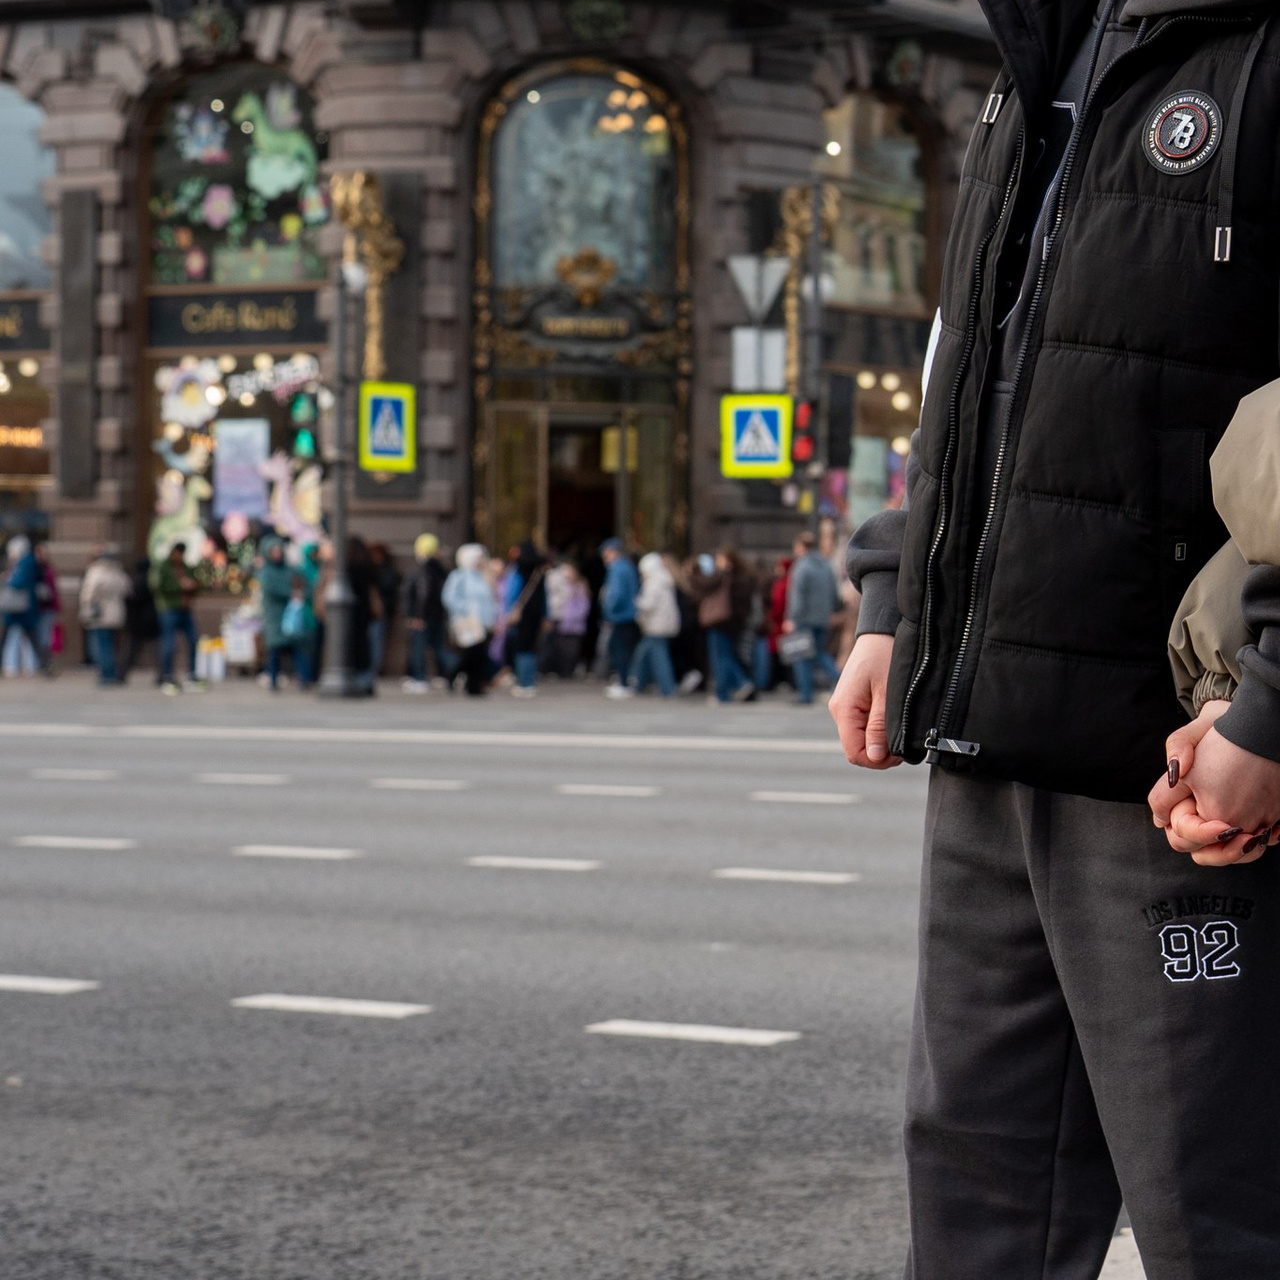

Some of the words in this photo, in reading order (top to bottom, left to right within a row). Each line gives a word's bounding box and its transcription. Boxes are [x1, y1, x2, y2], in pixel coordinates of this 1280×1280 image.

[1142, 901, 1174, 927] LOS
[1174, 895, 1255, 921] ANGELES
[1158, 920, 1241, 982] 92
